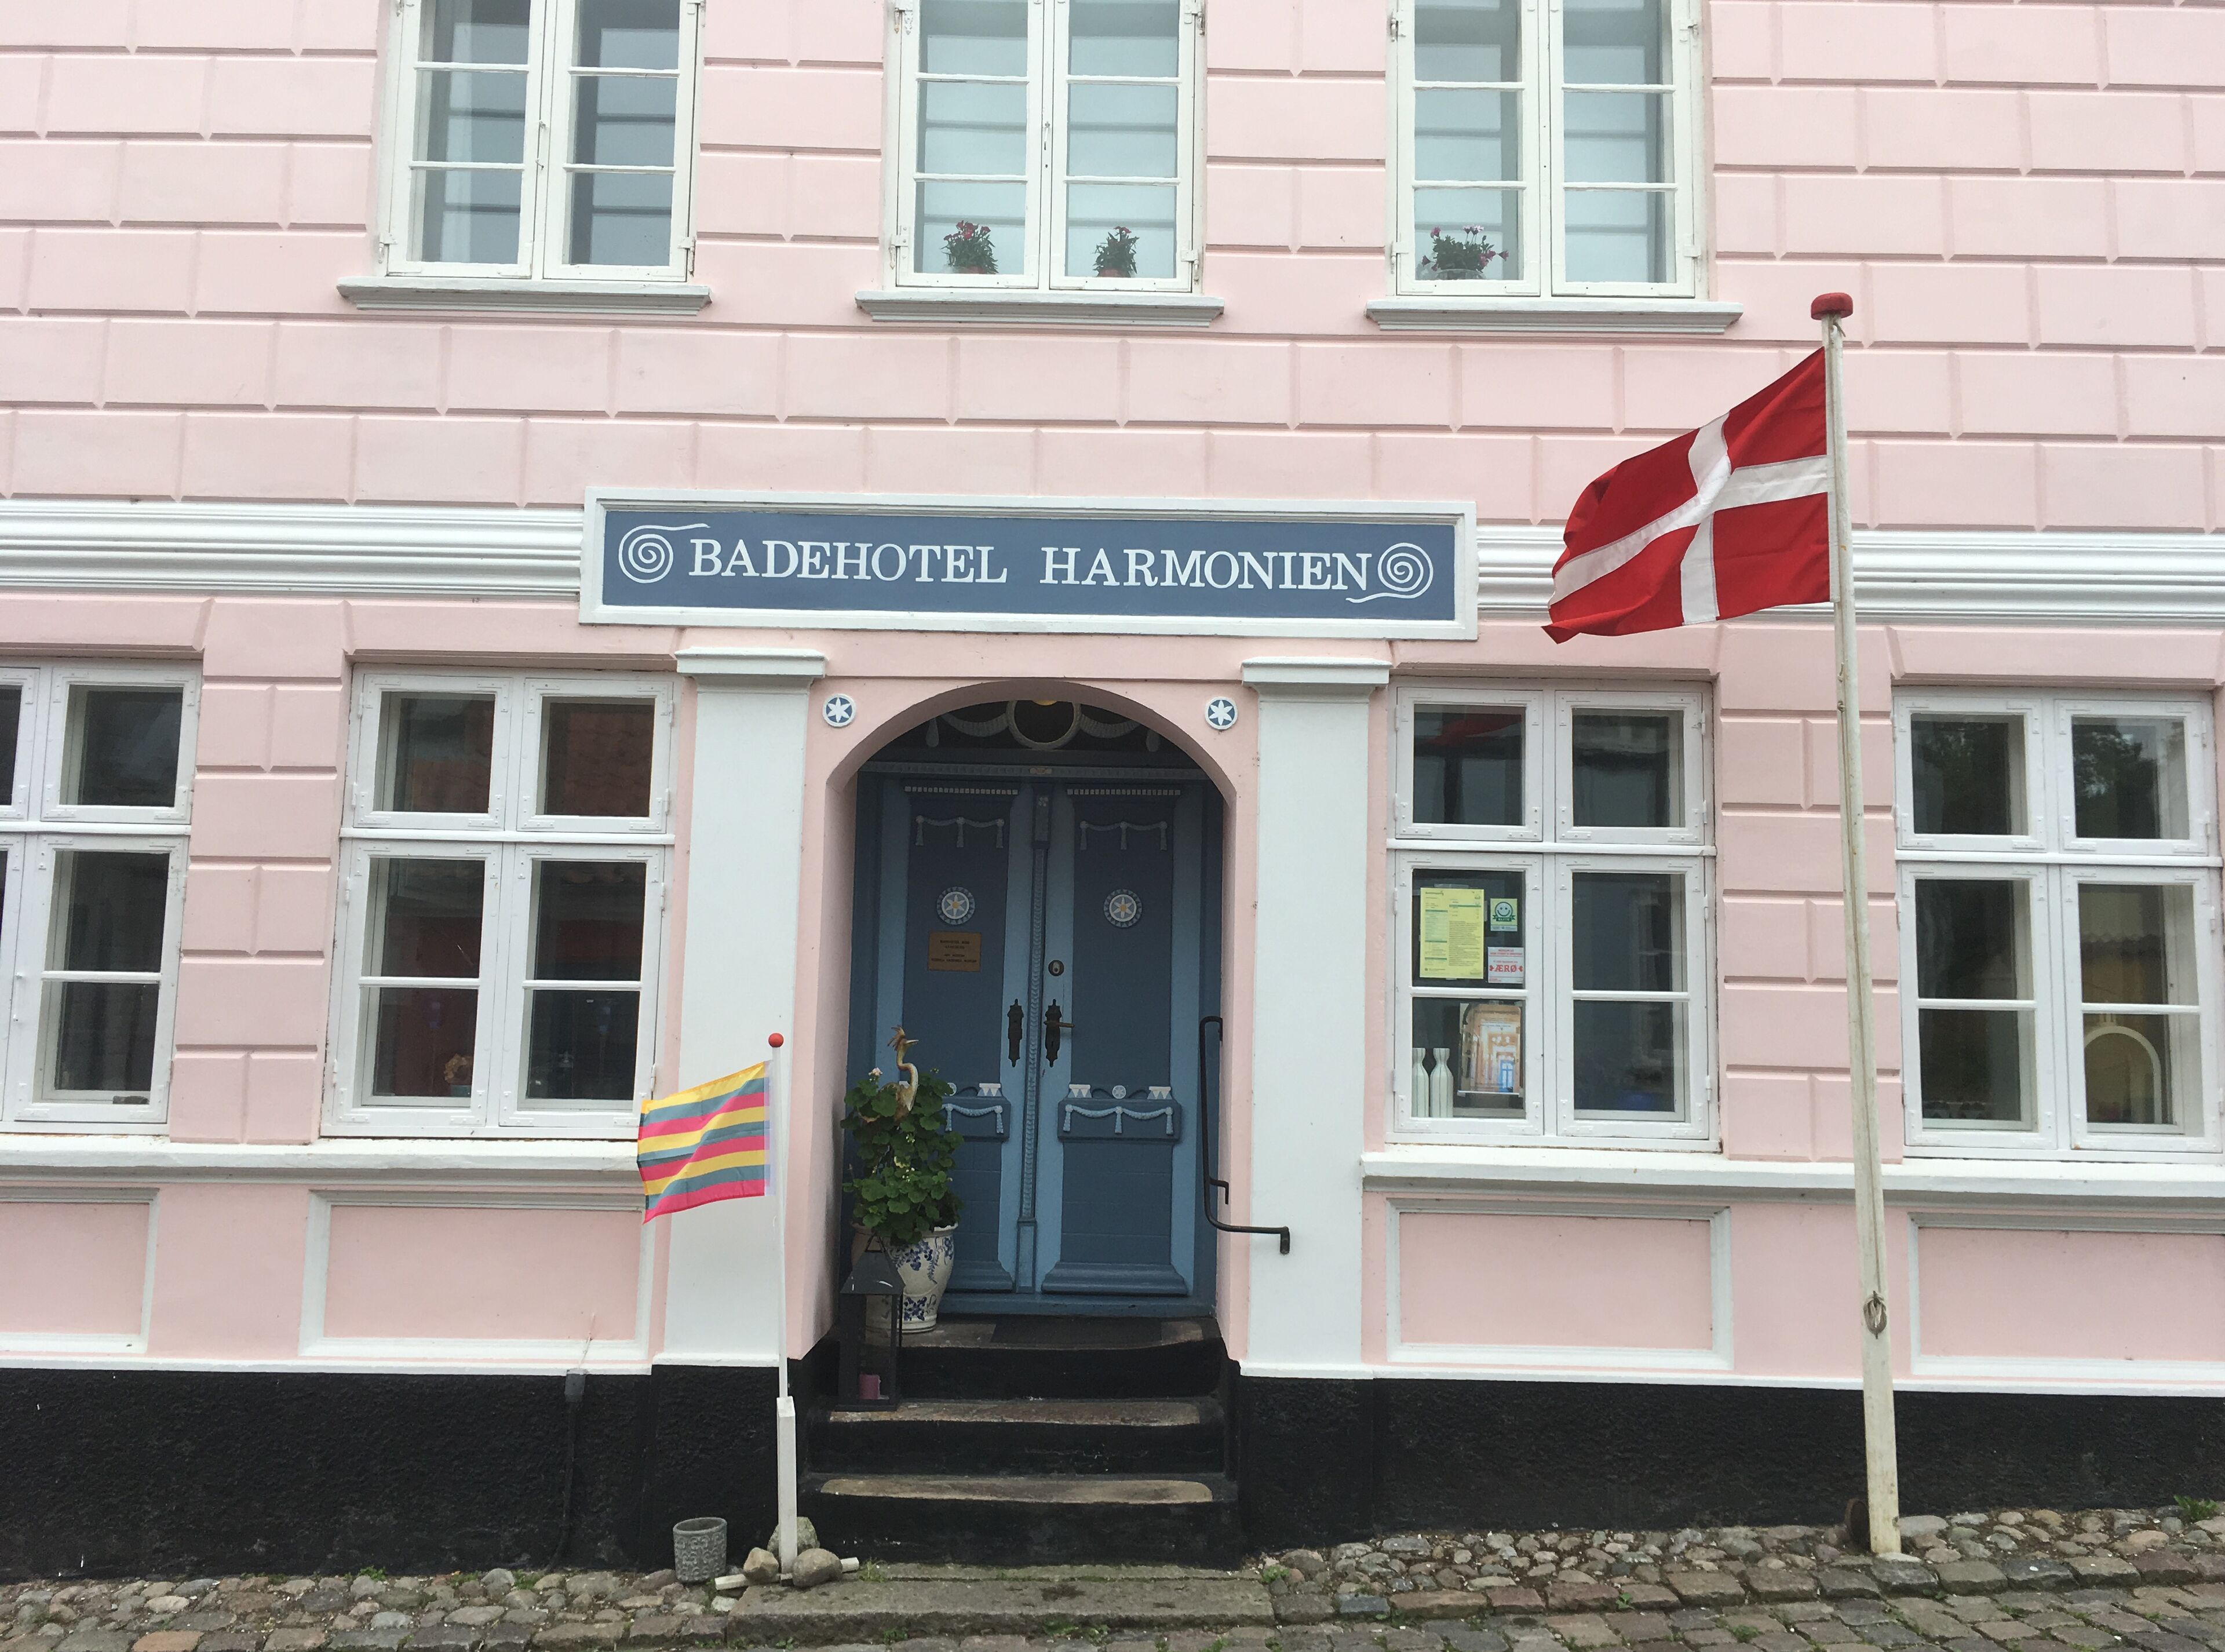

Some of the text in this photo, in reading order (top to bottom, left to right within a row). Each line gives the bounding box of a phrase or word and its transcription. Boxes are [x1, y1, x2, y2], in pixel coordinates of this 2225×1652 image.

[688, 538, 1372, 590] BADEHOTEL HARMONIEN
[1494, 964, 1517, 972] ÆRØ
